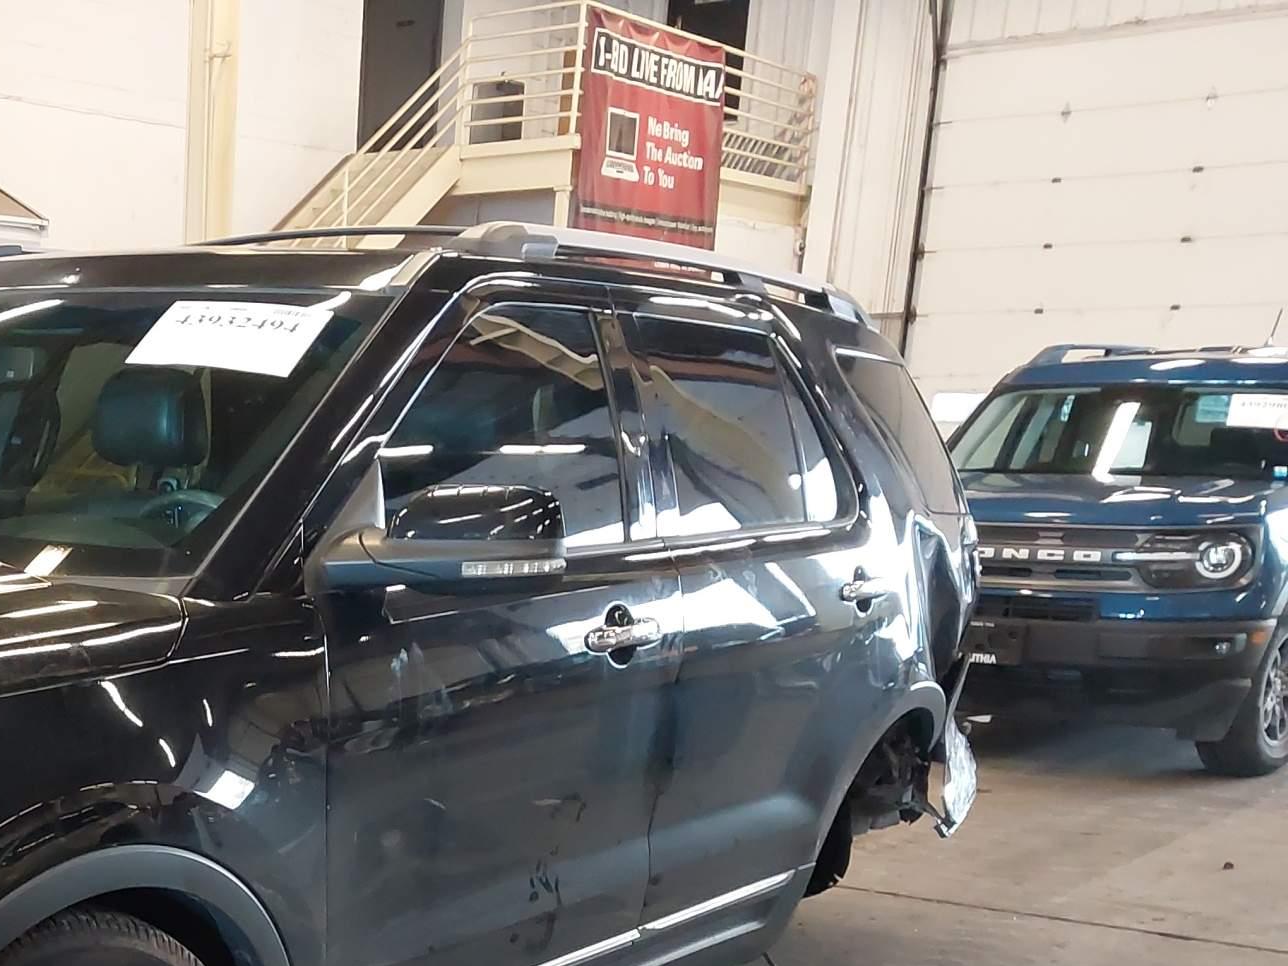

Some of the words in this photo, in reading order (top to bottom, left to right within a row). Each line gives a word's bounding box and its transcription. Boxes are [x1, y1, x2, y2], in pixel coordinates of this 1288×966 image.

[631, 47, 660, 83] LIVE
[660, 57, 696, 94] FROM
[663, 120, 689, 148] Bring
[645, 141, 663, 163] The
[643, 165, 655, 185] To
[657, 167, 675, 189] You
